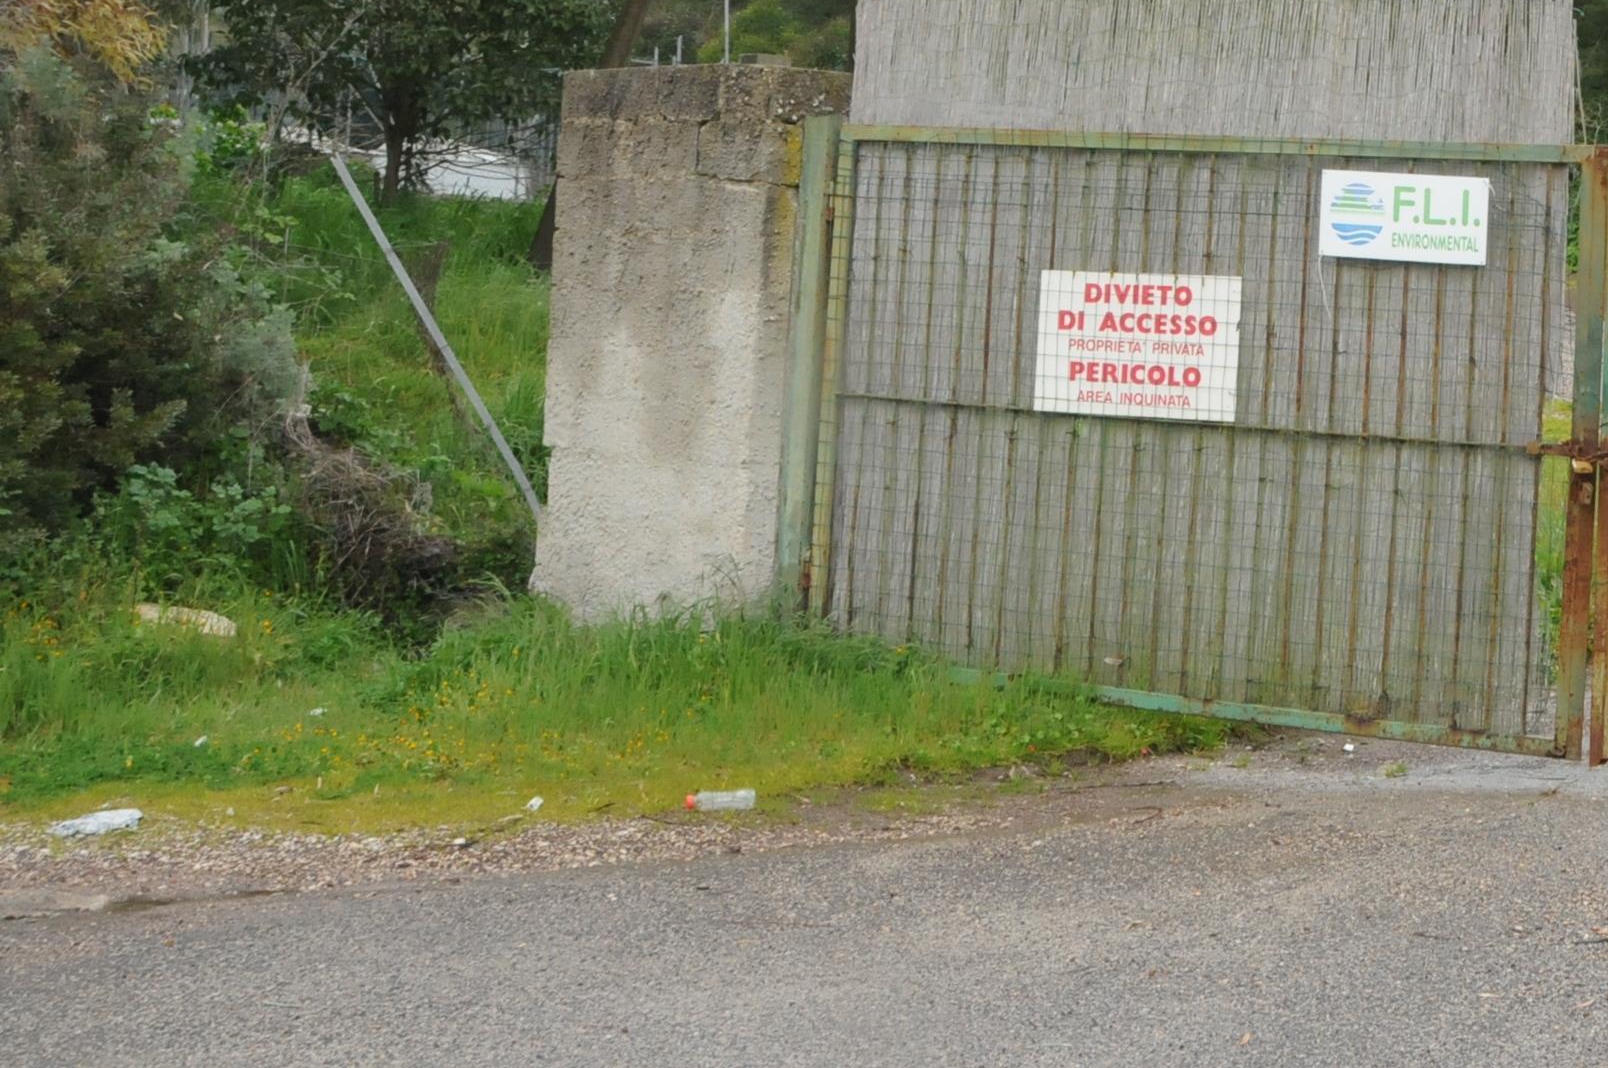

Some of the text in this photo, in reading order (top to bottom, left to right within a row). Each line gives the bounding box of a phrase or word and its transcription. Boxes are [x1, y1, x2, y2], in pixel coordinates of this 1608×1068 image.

[1392, 185, 1481, 227] F.L.I.
[1391, 232, 1479, 252] ENVIRONMENTAL
[1084, 283, 1193, 306] DIVIETO
[1057, 310, 1218, 336] DI ACCESSO
[1152, 342, 1205, 357] PRIVATA
[1068, 361, 1202, 388] PERICOLO
[1077, 390, 1191, 408] AREA INQUINATA
